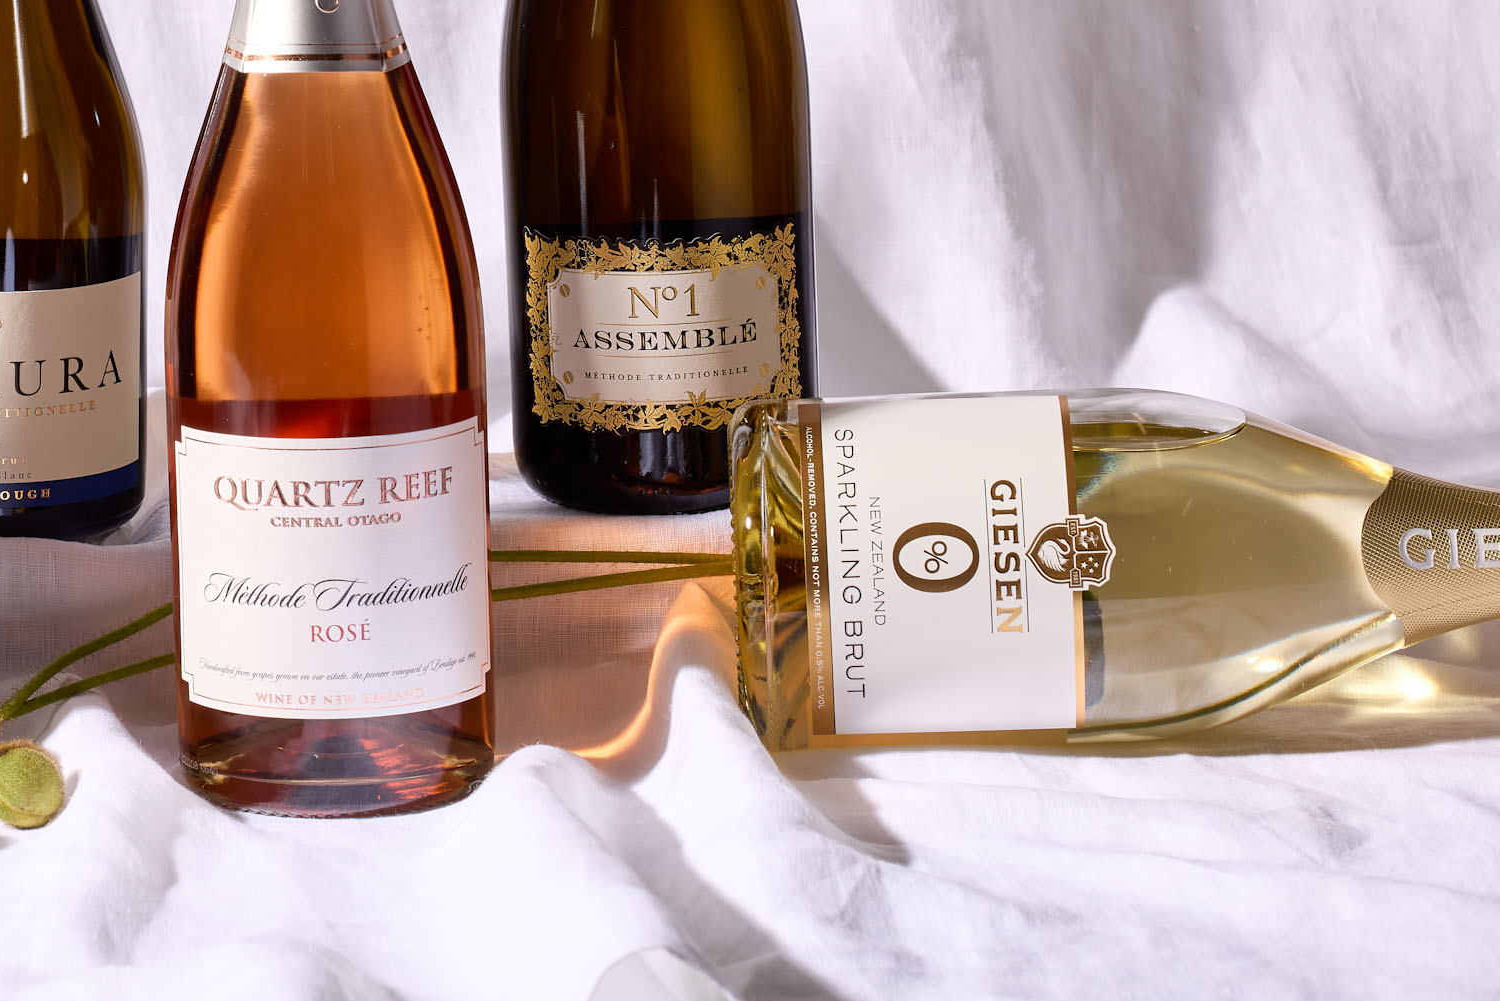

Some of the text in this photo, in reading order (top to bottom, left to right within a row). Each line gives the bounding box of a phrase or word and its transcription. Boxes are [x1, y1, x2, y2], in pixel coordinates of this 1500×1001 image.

[573, 318, 758, 351] ASSEMBLÉ
[213, 466, 453, 512] QUARTZ REEF
[270, 511, 402, 528] CENTRAL OTAGO
[809, 511, 819, 563] CONTAINS
[834, 428, 866, 699] SPARKLING BRUT
[869, 496, 886, 627] NEW ZEALAND
[989, 479, 1024, 634] GIESEN
[1399, 528, 1500, 571] GIE
[313, 562, 473, 612] Traditionnelle
[812, 565, 820, 587] NOT
[813, 589, 822, 618] MORE
[310, 618, 371, 643] ROSÉ
[815, 621, 823, 648] THAN
[255, 692, 293, 705] WINE
[298, 694, 317, 705] OF
[323, 694, 357, 705] NEW
